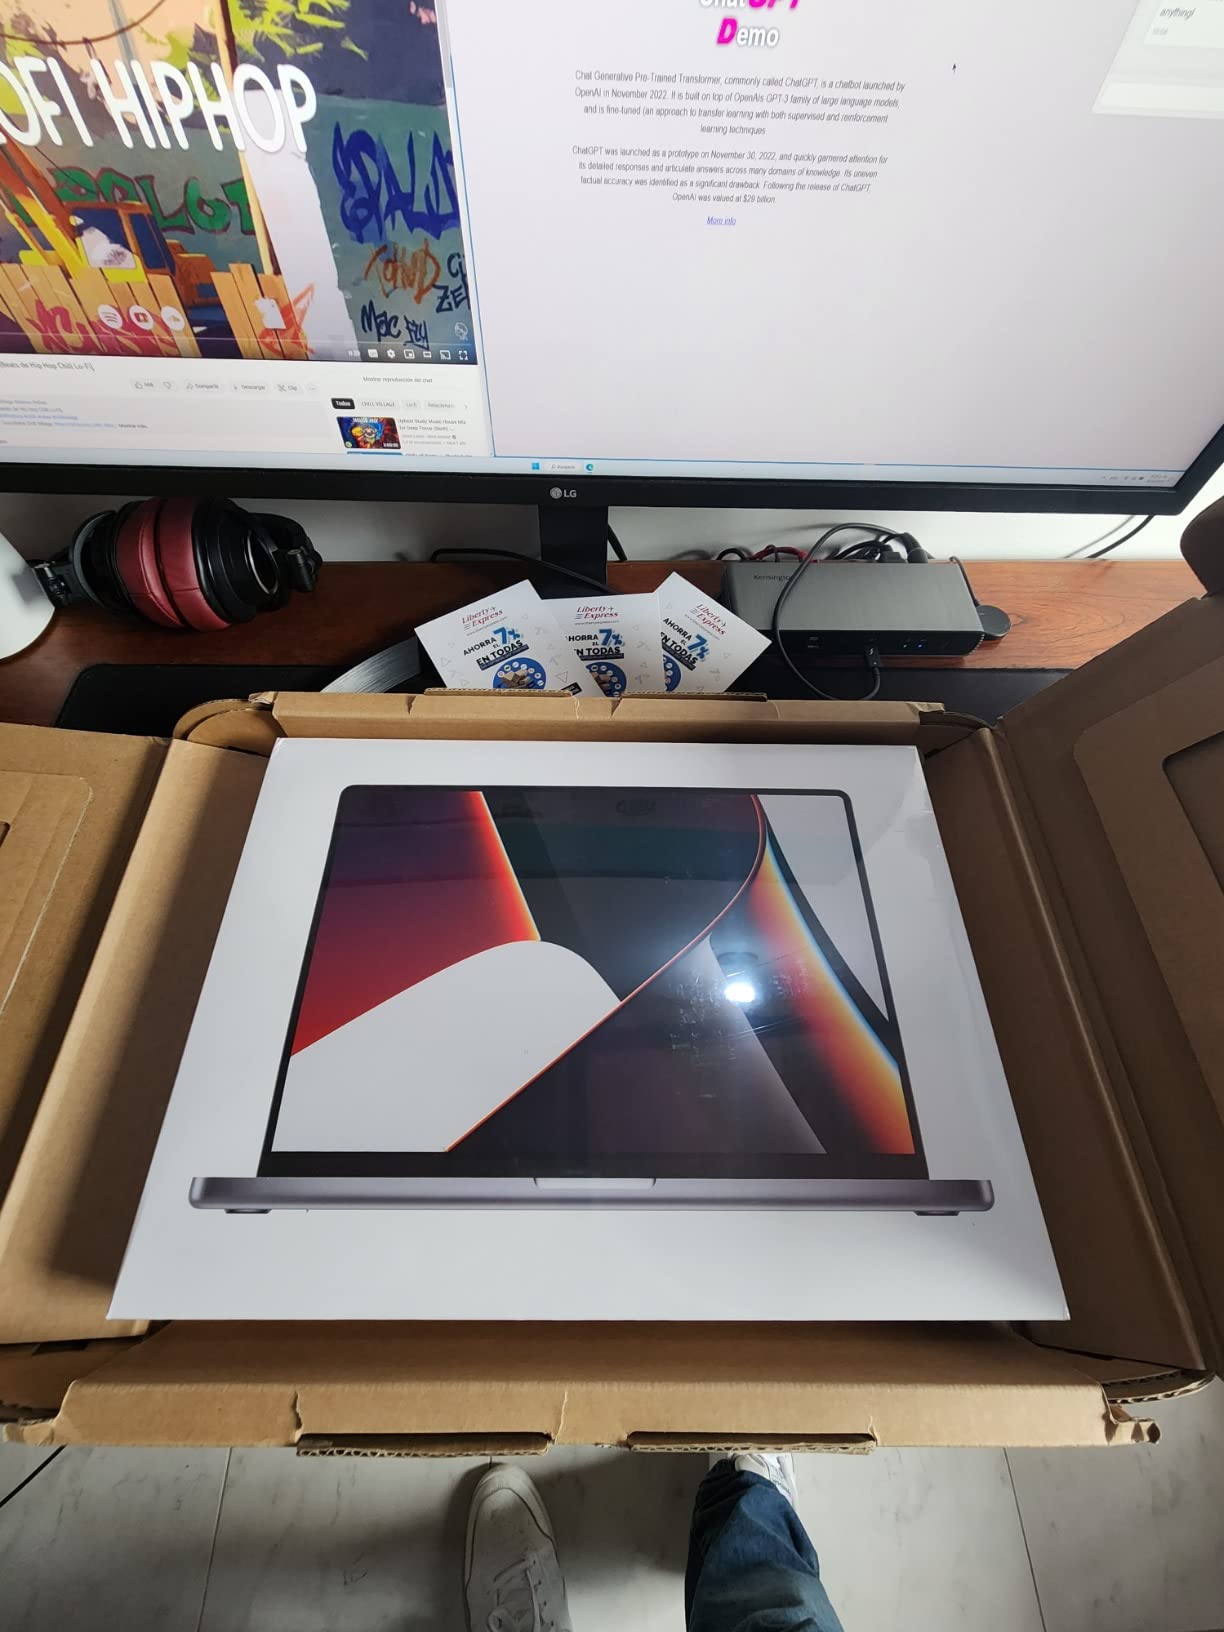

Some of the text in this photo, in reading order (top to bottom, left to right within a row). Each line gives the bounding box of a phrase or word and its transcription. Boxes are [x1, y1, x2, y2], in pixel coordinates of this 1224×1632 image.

[716, 17, 781, 48] Demo
[575, 70, 592, 81] Chat
[594, 71, 633, 82] Generative
[725, 76, 760, 87] commonly
[763, 77, 783, 87] called
[821, 79, 826, 88] is
[835, 80, 861, 90] chatbot
[863, 81, 895, 91] launched
[897, 82, 905, 93] by
[0, 56, 94, 147] OFI
[575, 87, 601, 99] OpenAI
[603, 88, 609, 97] in
[612, 89, 648, 99] November
[678, 91, 683, 100] is
[685, 91, 700, 100] built
[701, 93, 711, 101] on
[712, 92, 723, 102] top
[725, 92, 733, 101] of
[790, 94, 811, 106] family
[812, 95, 820, 104] of
[821, 96, 838, 107] large
[840, 97, 871, 109] language
[584, 104, 597, 114] and
[599, 105, 604, 114] is
[656, 107, 687, 117] approach
[690, 108, 696, 117] to
[699, 108, 725, 118] transfer
[726, 109, 753, 120] learning
[755, 110, 769, 119] with
[771, 110, 786, 119] both
[788, 111, 825, 121] supervised
[826, 112, 839, 122] and
[841, 113, 888, 123] reinforcement
[701, 124, 727, 136] learning
[572, 146, 604, 155] ChatGPT
[605, 147, 618, 156] was
[620, 147, 651, 157] launched
[652, 149, 660, 157] as
[668, 149, 699, 159] prototype
[711, 150, 745, 159] November
[779, 152, 792, 161] and
[794, 153, 816, 163] quickly
[818, 154, 847, 164] garnered
[849, 154, 877, 164] attention
[878, 155, 888, 164] for
[588, 162, 614, 171] detailed
[616, 163, 649, 173] responses
[651, 163, 663, 172] and
[665, 163, 695, 173] articulate
[696, 165, 723, 173] answers
[725, 166, 747, 174] across
[748, 167, 766, 177] many
[768, 167, 796, 176] domains
[798, 167, 805, 176] of
[581, 175, 602, 185] factual
[604, 177, 633, 186] accuracy
[635, 178, 648, 186] was
[650, 177, 678, 187] identified
[680, 179, 688, 187] as
[696, 179, 727, 190] significant
[763, 181, 794, 191] Following
[795, 182, 805, 191] the
[807, 182, 831, 191] release
[833, 183, 840, 191] of
[672, 192, 696, 203] OpenAI
[698, 193, 711, 202] was
[712, 193, 734, 202] valued
[735, 194, 742, 202] at
[743, 194, 755, 203] $29
[707, 216, 723, 226] More
[563, 489, 577, 498] LG
[461, 608, 492, 625] Liberty
[471, 609, 503, 628] Express
[583, 612, 619, 620] Express
[696, 603, 722, 624] Liberty
[662, 617, 692, 641] AHORRA
[697, 613, 726, 636] Express
[462, 637, 498, 656] AHORRA
[565, 628, 624, 647] HORRA 7%
[475, 654, 492, 669] EN
[489, 639, 524, 662] TODAS
[574, 646, 622, 656] N TODAS
[671, 640, 699, 665] TODAS
